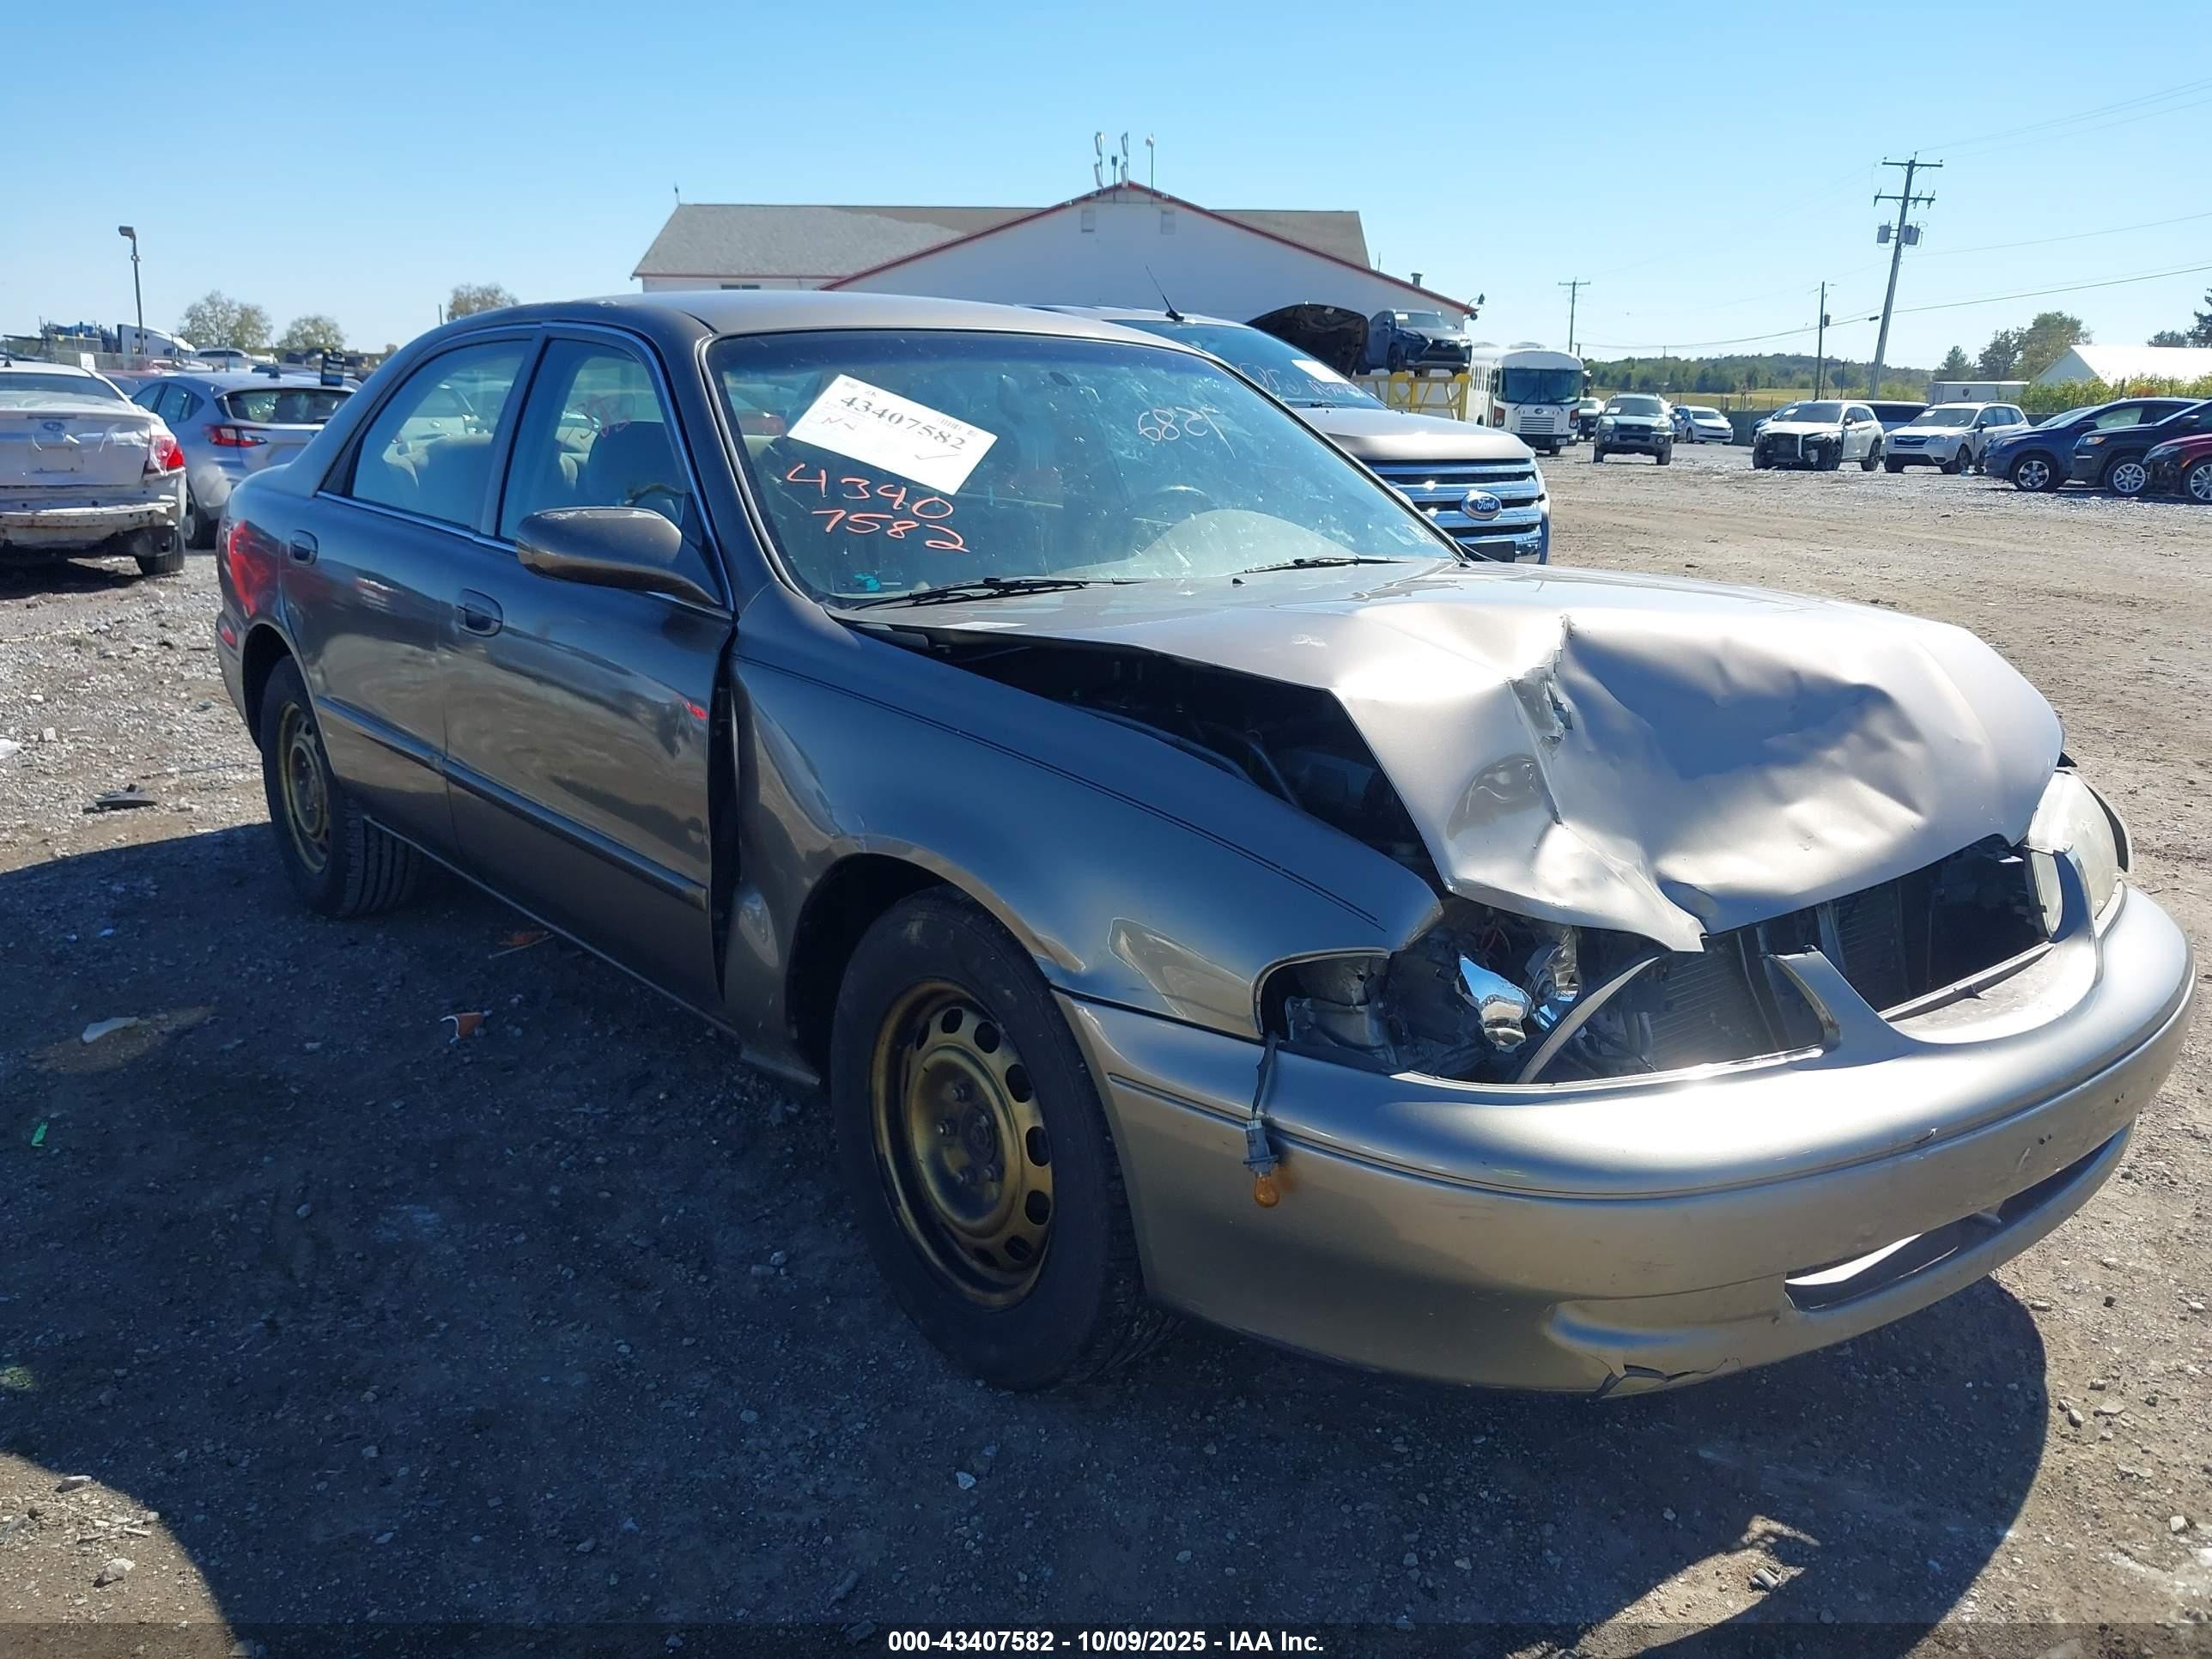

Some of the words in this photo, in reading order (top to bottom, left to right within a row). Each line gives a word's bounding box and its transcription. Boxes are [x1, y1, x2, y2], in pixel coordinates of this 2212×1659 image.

[840, 396, 967, 451] 43407582
[786, 463, 954, 520] 4340
[1477, 496, 1496, 510] Ford
[811, 508, 970, 553] 7582
